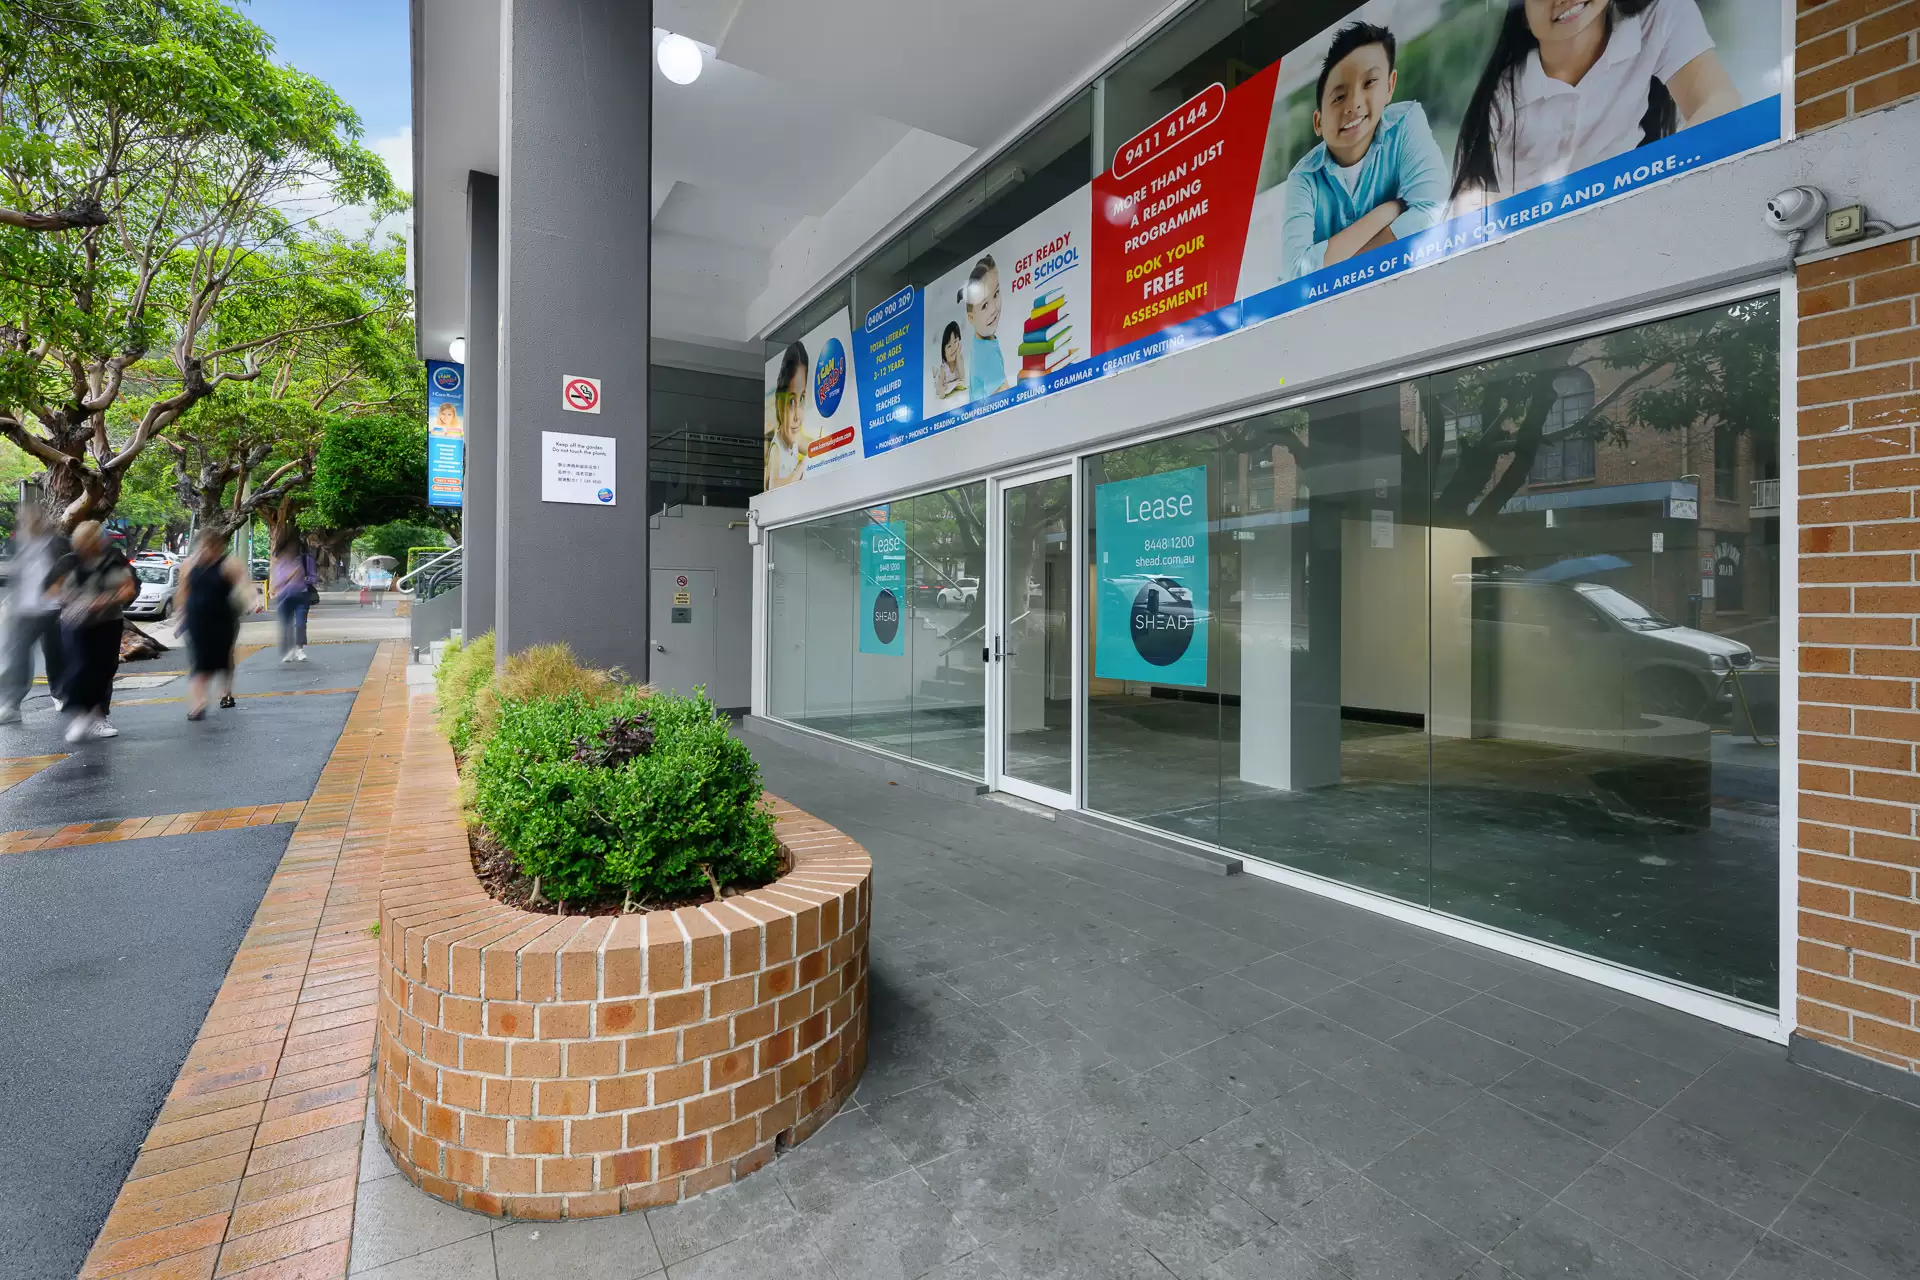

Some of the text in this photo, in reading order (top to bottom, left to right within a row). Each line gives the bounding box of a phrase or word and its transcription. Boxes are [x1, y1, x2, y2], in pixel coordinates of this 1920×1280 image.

[1125, 101, 1207, 165] 9411 4144
[1113, 140, 1224, 217] MORE THAN JUST
[1130, 178, 1202, 229] A READING
[1124, 198, 1209, 254] PROGRAMME
[1308, 154, 1701, 299] ALL AREAS OF NAPLAN COVERED AND MORE...
[1015, 231, 1071, 274] GET READY
[1125, 234, 1205, 283] BOOK YOUR
[1012, 247, 1079, 293] FOR SCHOOL
[1143, 266, 1184, 300] FREE
[868, 292, 911, 327] 0400 900 209
[1122, 281, 1208, 329] ASSESSMENT!
[869, 323, 910, 353] TOTAL LITERACY
[821, 357, 835, 379] CAN
[873, 357, 905, 381] 3-12 YEARS
[876, 343, 902, 365] FOR AGES
[875, 379, 902, 398] QUALIFIED
[875, 394, 901, 412] TEACHERS
[878, 334, 1185, 449] PHONOLOGY PHONICS READING COMPREHENSION SPELLING GRAMMAR CREATIVE WRITING
[869, 416, 885, 430] SMALL
[1126, 494, 1193, 523] Lease
[872, 535, 900, 554] Lease
[1144, 535, 1195, 551] 8448 1200
[1135, 553, 1195, 567] shead.com.au
[875, 611, 897, 622] SHEAD
[1135, 614, 1188, 630] SHEAD
